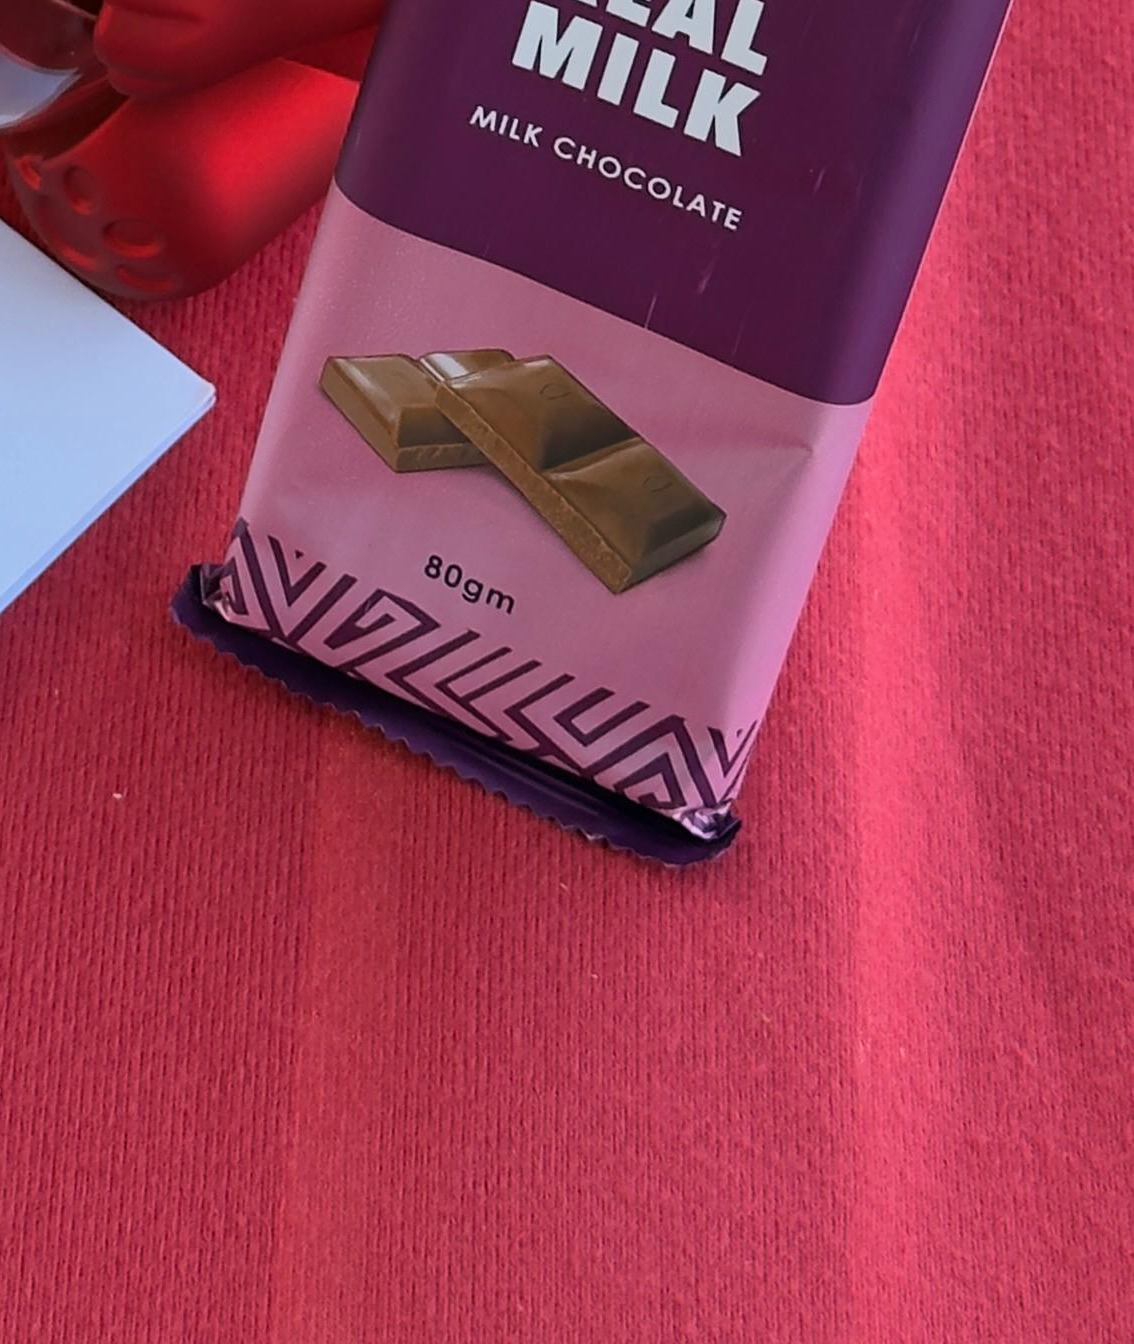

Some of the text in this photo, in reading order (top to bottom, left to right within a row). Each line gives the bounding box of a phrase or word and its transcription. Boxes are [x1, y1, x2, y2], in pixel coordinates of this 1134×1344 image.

[511, 0, 761, 157] MILK
[469, 105, 744, 231] MILK CHOCOLATE
[424, 554, 515, 615] 80gm
